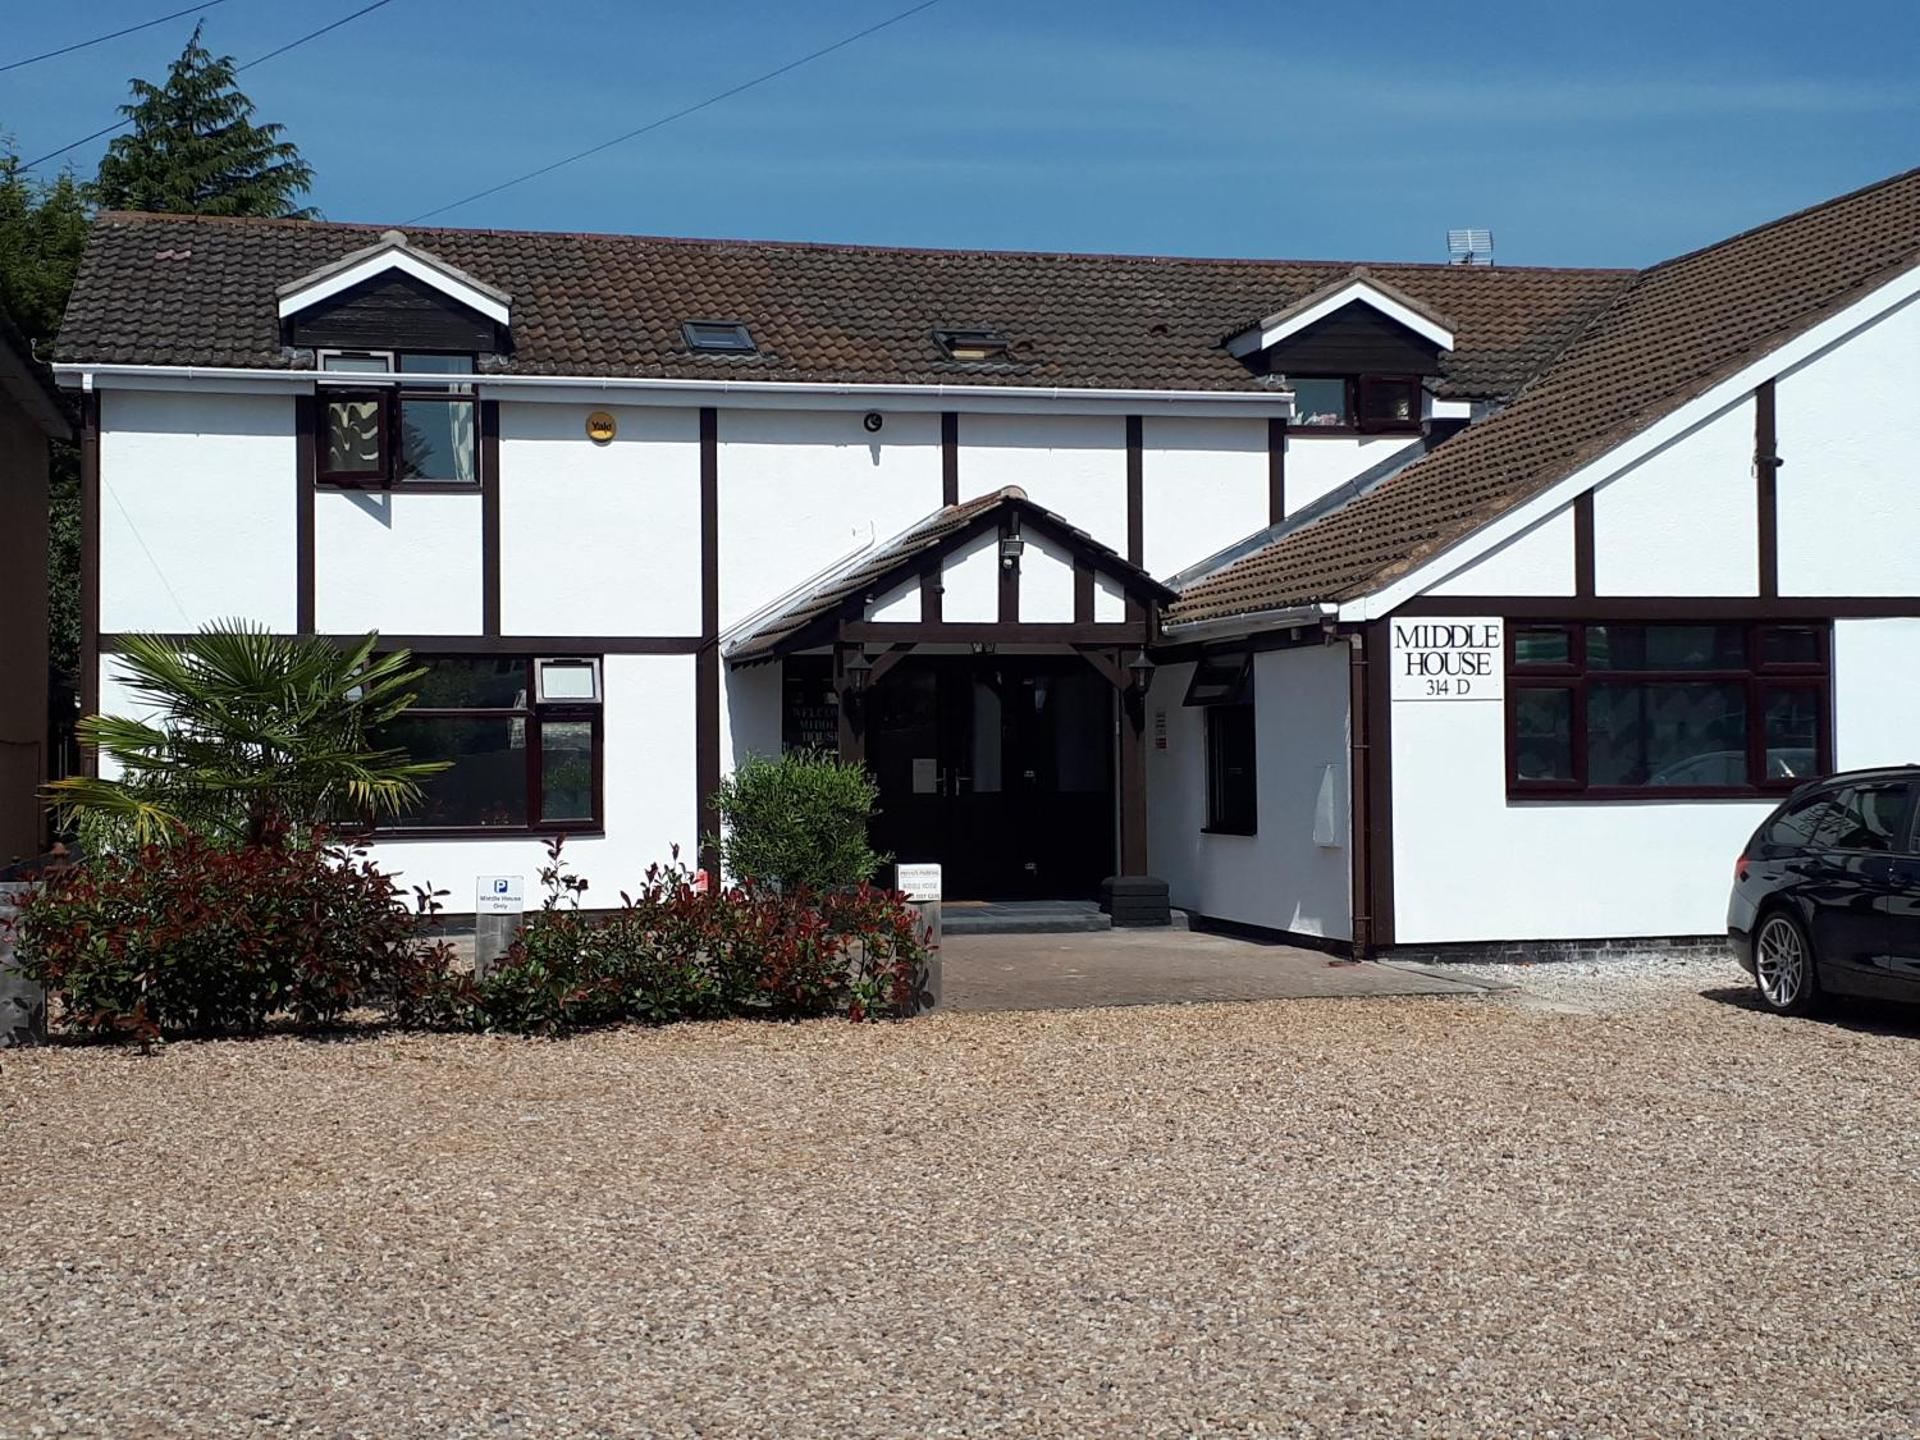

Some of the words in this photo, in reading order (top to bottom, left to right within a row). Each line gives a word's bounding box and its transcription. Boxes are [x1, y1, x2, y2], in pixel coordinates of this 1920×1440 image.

[1394, 625, 1500, 648] MIDDLE
[1404, 651, 1492, 676] HOUSE
[1426, 679, 1449, 695] 314
[1456, 679, 1471, 695] D
[496, 880, 506, 893] P
